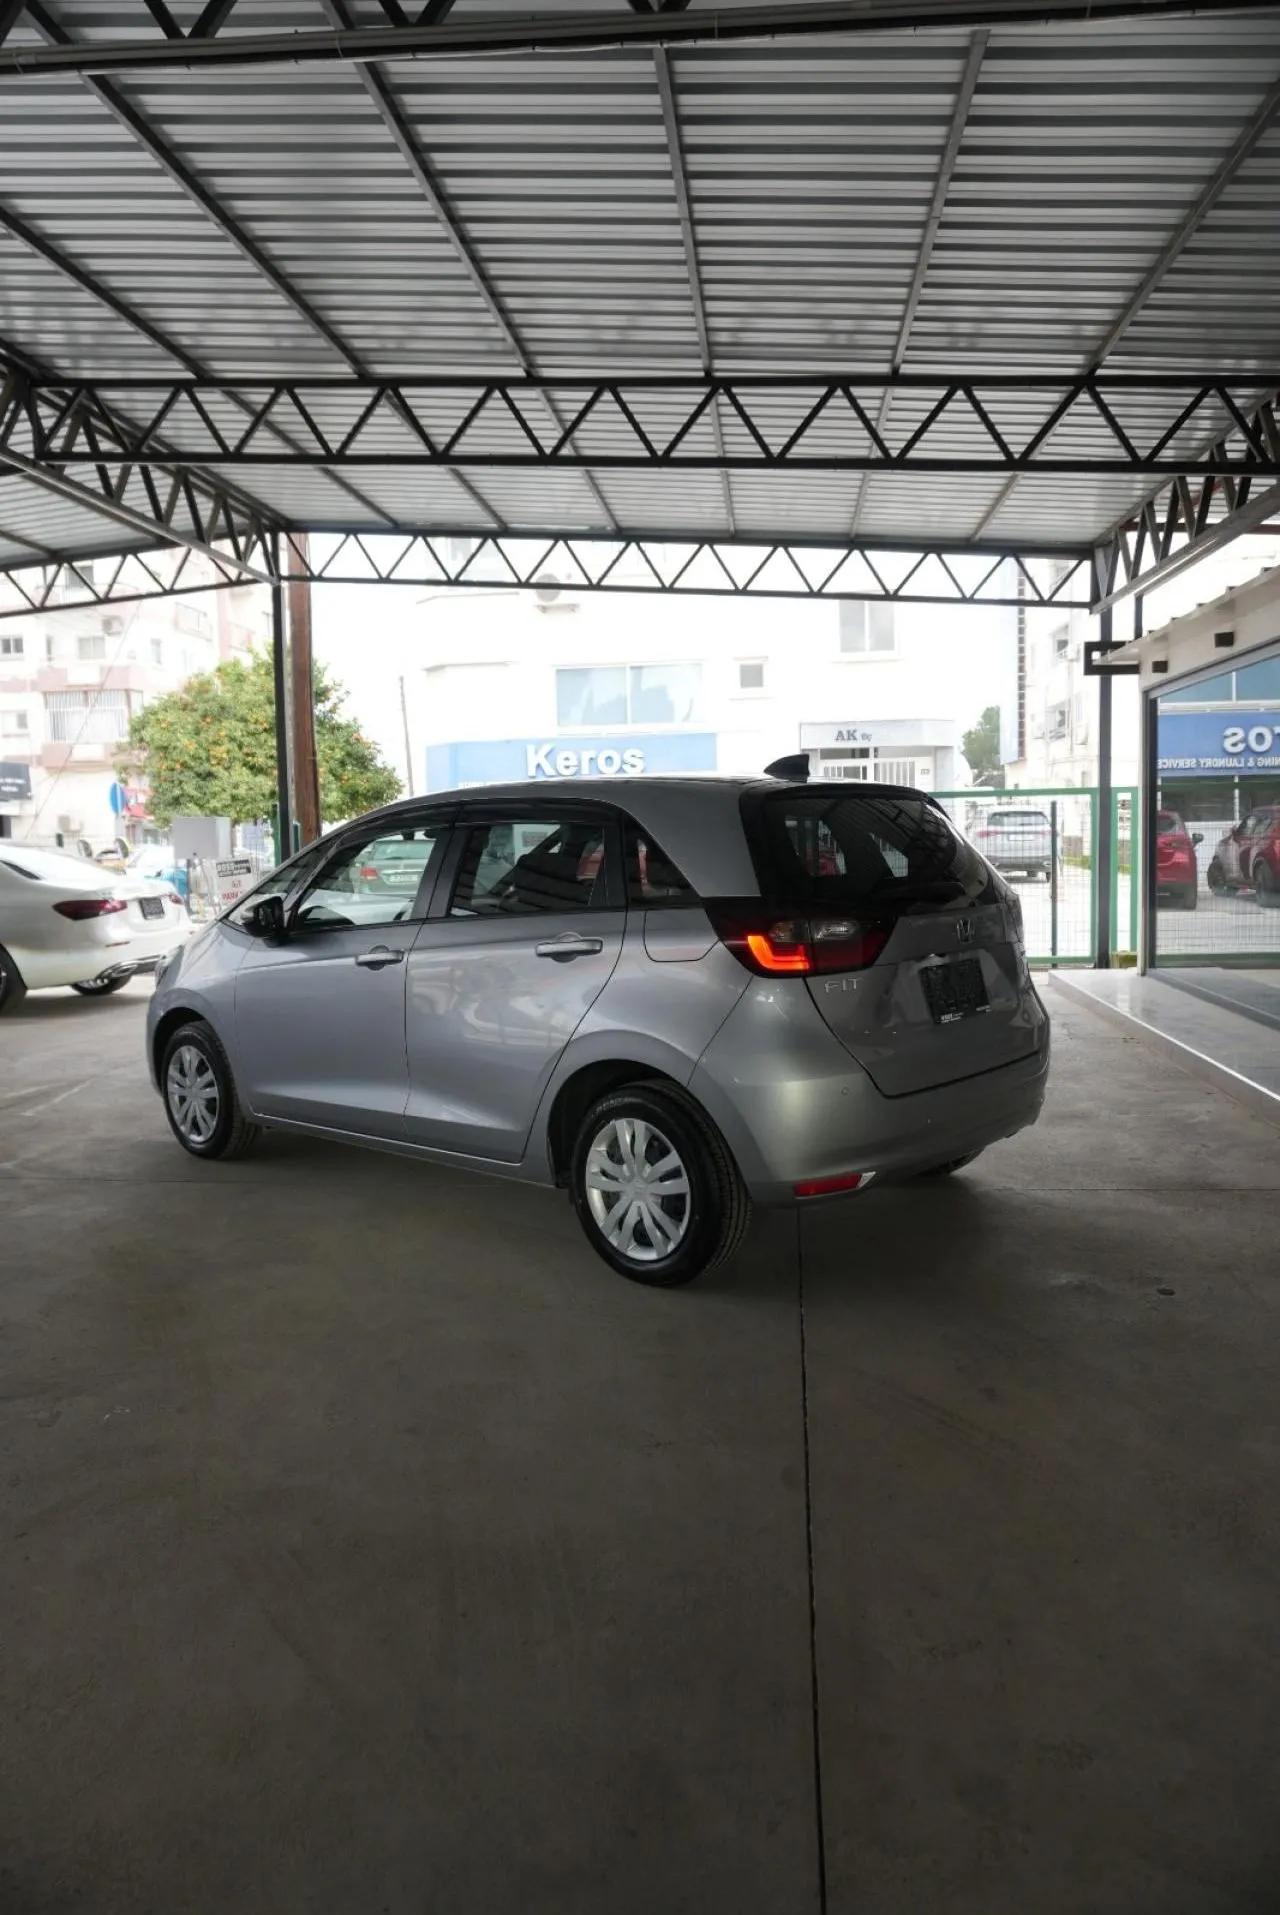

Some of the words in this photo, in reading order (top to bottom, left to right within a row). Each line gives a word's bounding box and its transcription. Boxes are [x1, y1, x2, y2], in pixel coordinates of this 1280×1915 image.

[835, 728, 858, 741] AK
[525, 743, 645, 778] Keros
[824, 977, 861, 993] FIT
